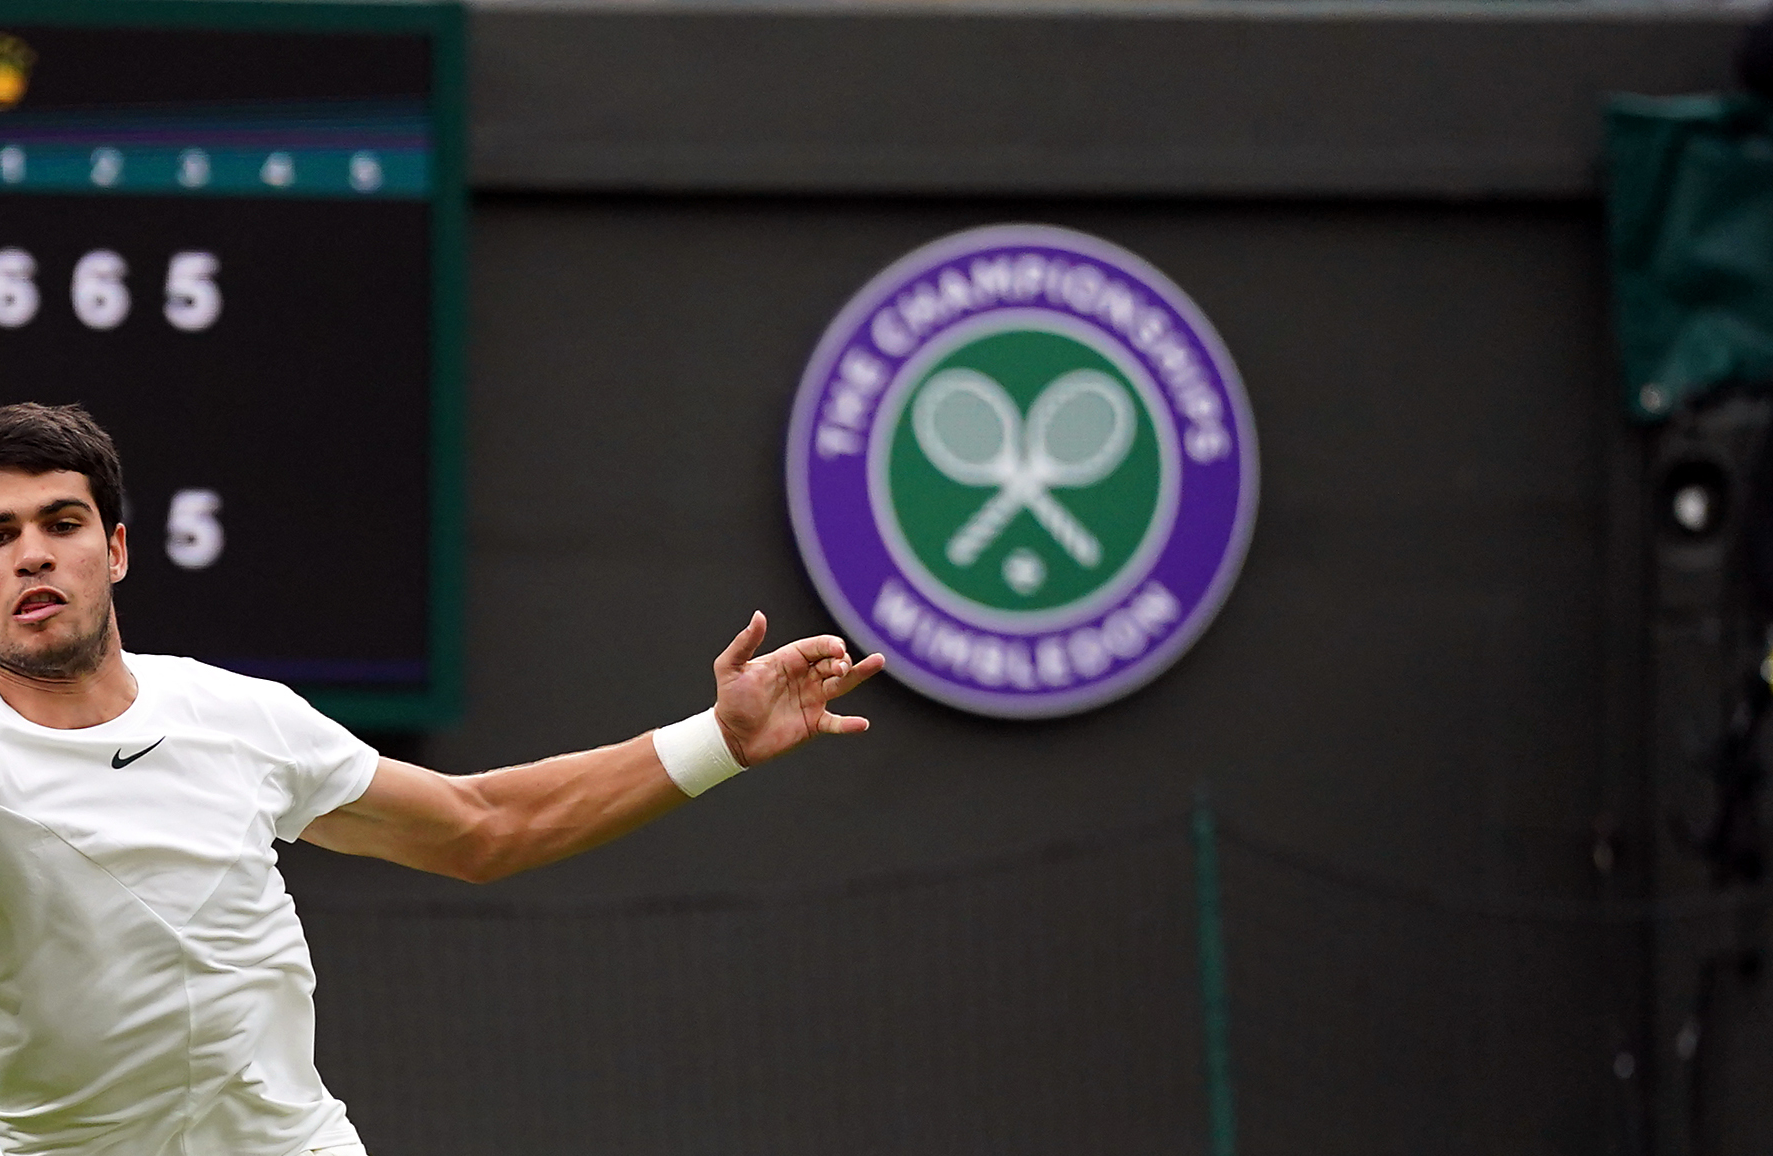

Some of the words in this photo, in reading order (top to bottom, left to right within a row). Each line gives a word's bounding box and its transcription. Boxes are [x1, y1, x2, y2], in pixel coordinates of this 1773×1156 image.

[89, 148, 124, 188] 2
[178, 149, 211, 189] 3
[260, 153, 296, 188] 4
[349, 152, 383, 193] 5
[71, 250, 130, 330] 6
[164, 251, 222, 331] 5
[816, 346, 886, 459] THE
[870, 254, 1231, 464] CHAMPIONSHIPS
[165, 488, 223, 569] 5
[872, 577, 1181, 690] WIMBLEDON
